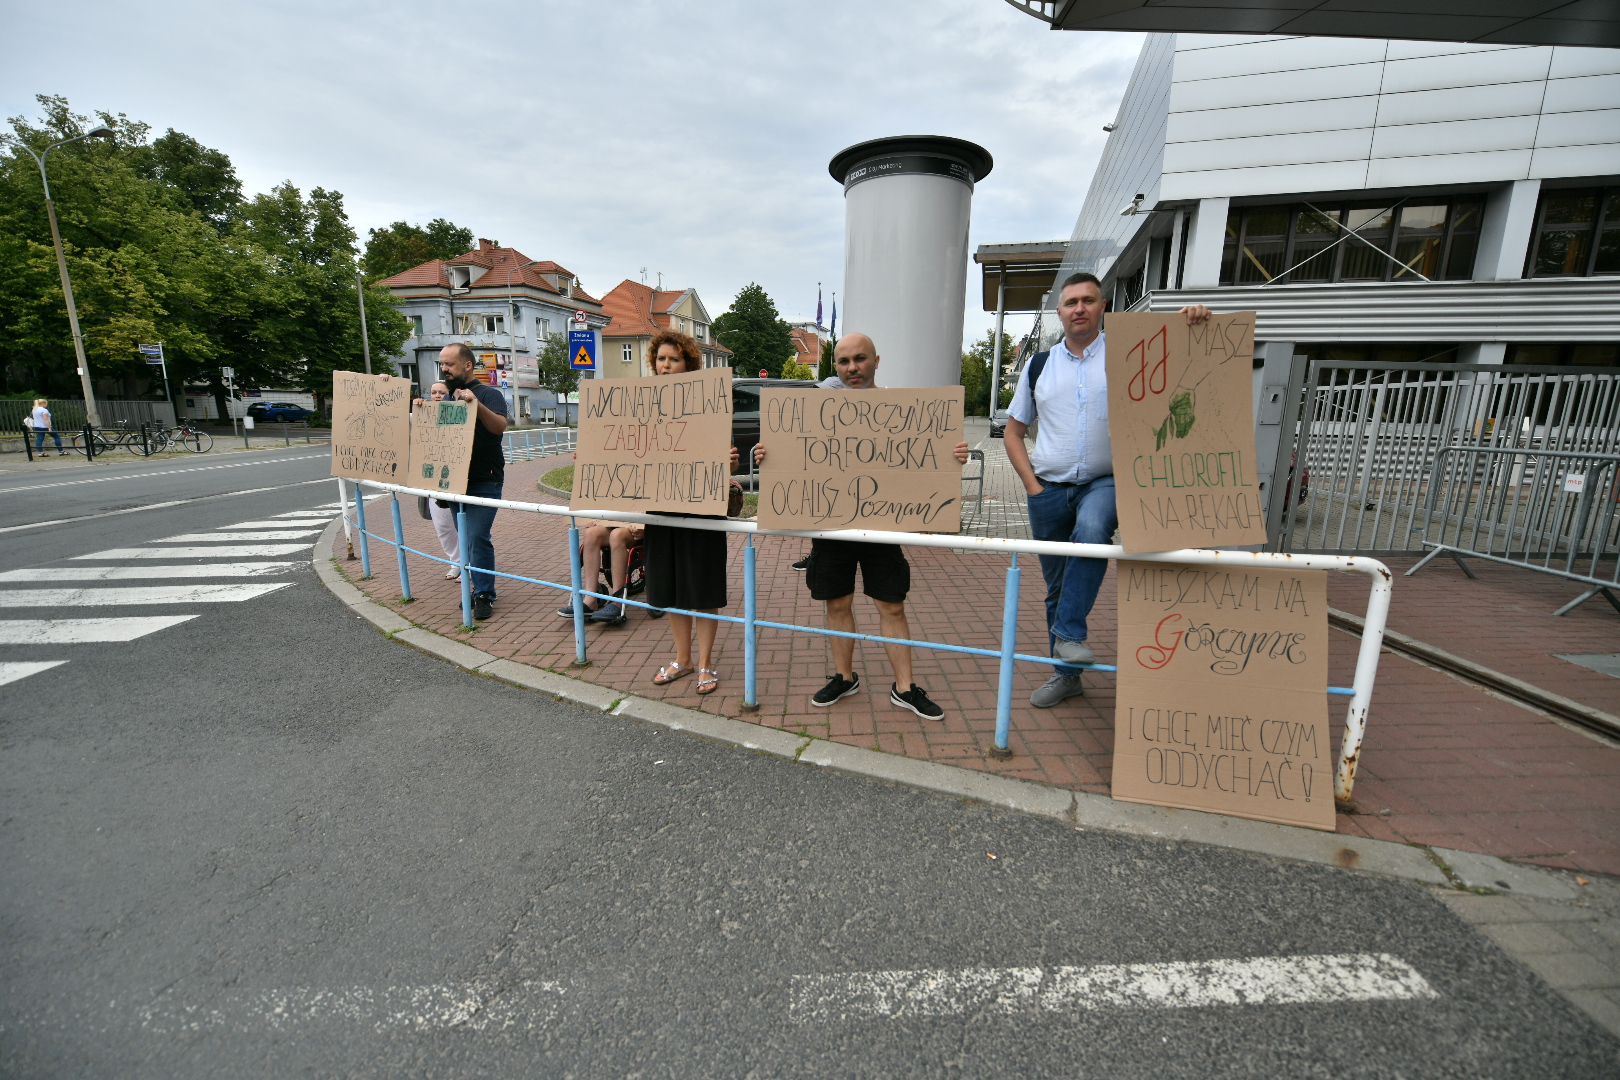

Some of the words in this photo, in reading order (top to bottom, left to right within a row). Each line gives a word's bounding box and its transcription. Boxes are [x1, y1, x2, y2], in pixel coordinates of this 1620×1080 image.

[1187, 319, 1252, 365] MASZ
[586, 384, 668, 425] WYCINAJĄC
[603, 421, 687, 458] ZABIJASZ
[797, 437, 938, 473] TORFOWISKA
[1133, 450, 1252, 488] CHLOROFIL
[771, 478, 843, 525] OCALISZ
[841, 475, 956, 525] Poznań
[1140, 497, 1183, 530] NA
[1186, 493, 1264, 539] RĘKACH
[1127, 567, 1260, 611] MIESZKAM
[1274, 578, 1309, 616] NA
[1129, 708, 1134, 739] I
[1142, 708, 1197, 751] CHCĘ
[1205, 715, 1252, 752] MIEĆ
[1260, 719, 1318, 759] CZYM
